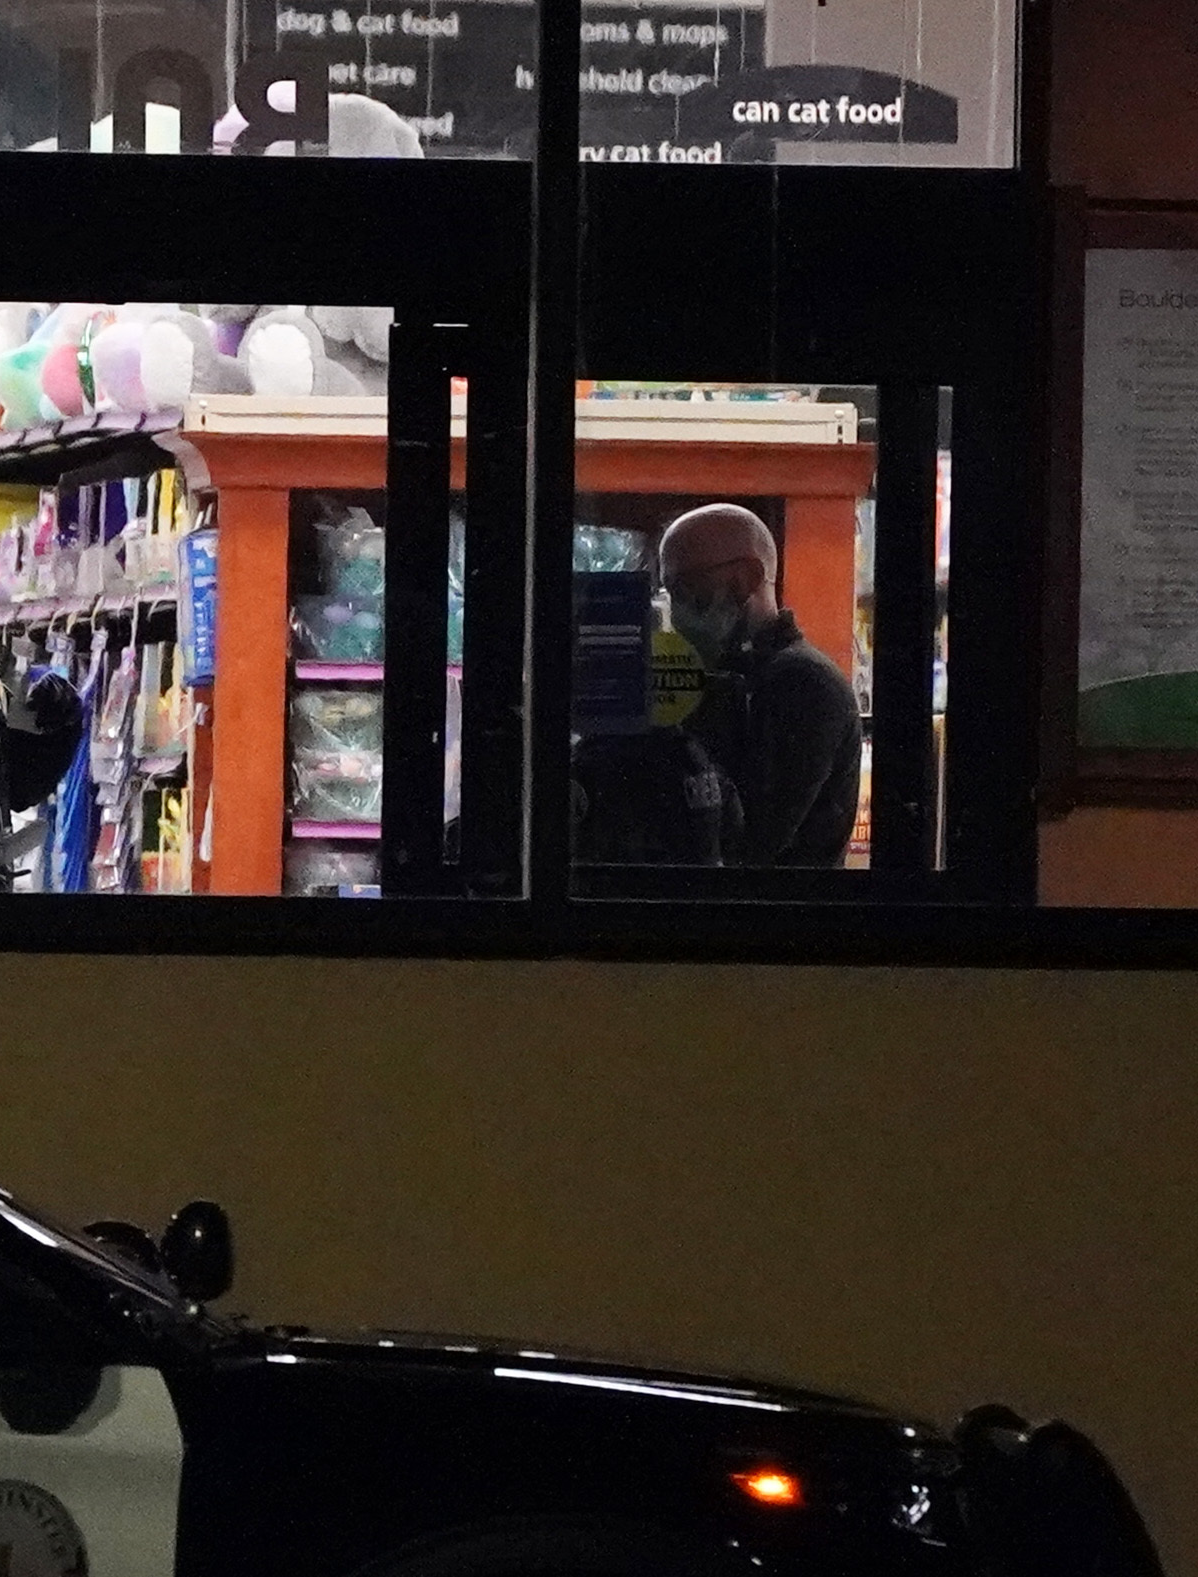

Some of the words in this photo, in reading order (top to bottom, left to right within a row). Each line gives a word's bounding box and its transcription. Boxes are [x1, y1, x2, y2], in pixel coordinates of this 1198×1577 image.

[277, 9, 326, 36] dog
[331, 9, 352, 33] &
[357, 14, 394, 35] cat
[402, 9, 458, 37] food
[636, 19, 655, 44] &
[663, 24, 728, 48] mops
[363, 63, 416, 86] care
[732, 101, 780, 123] can
[788, 98, 830, 123] cat
[837, 95, 902, 124] food
[609, 145, 652, 162] cat
[658, 141, 722, 163] food
